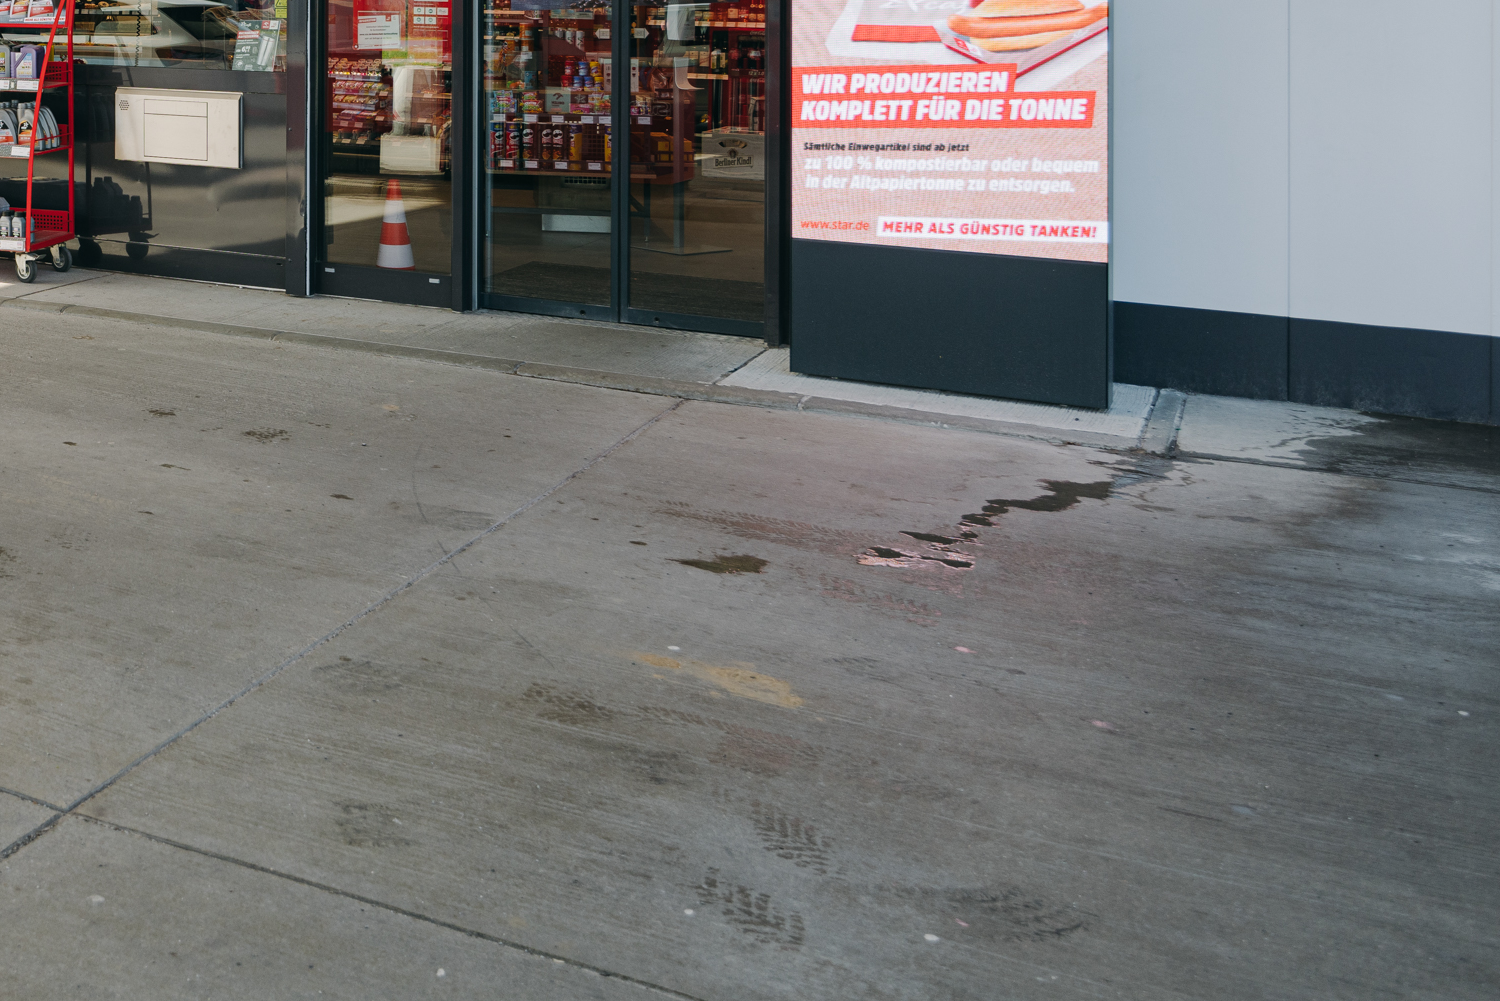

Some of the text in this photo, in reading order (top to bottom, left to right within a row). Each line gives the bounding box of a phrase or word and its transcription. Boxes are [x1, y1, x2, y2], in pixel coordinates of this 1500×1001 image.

[801, 70, 1010, 95] WIR PRODUZIEREN
[800, 95, 1088, 121] KOMPLETT FÜR DIE TONNE
[803, 141, 970, 154] Sämtliche Einwegartikel sind ab jetzt
[714, 157, 752, 167] Berliner Kindl
[804, 155, 1099, 174] zu 100 % kompostierbar oder bequem
[805, 174, 1076, 195] in der Altpapiertonne zu entsorgen.
[800, 219, 1098, 239] www.star.de MEHR ALS GÜNSTIG TANKEN!
